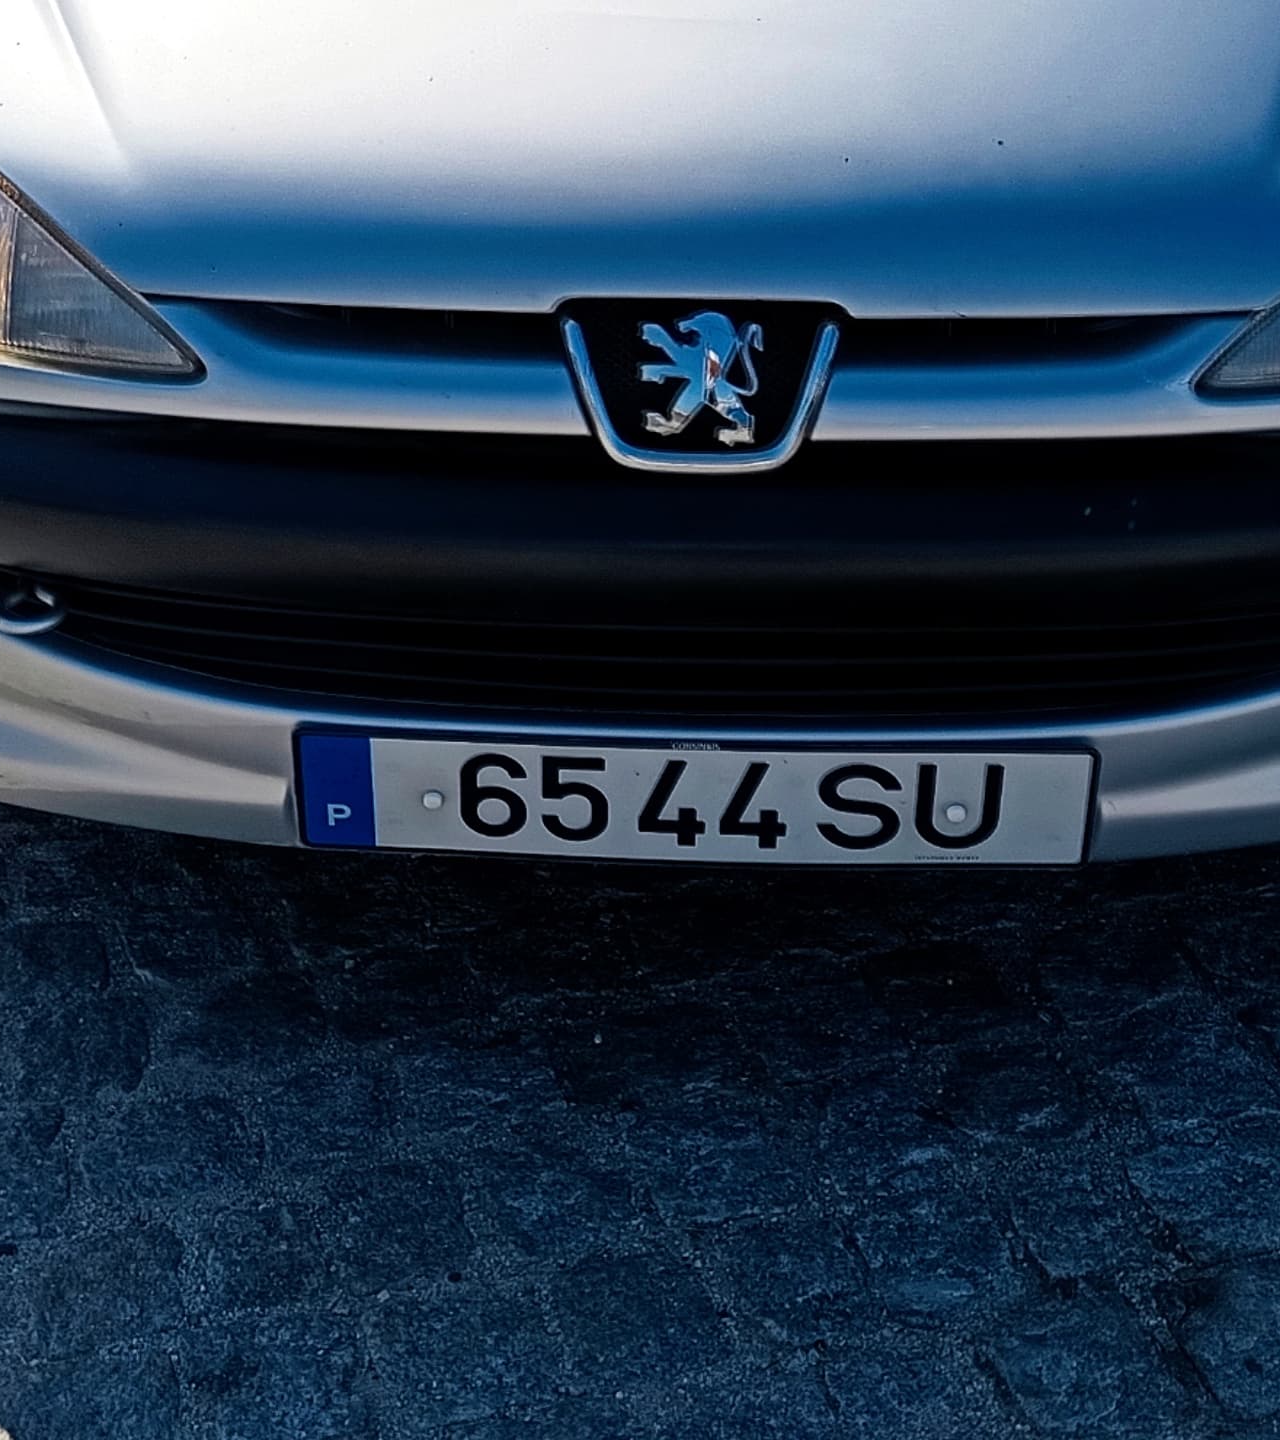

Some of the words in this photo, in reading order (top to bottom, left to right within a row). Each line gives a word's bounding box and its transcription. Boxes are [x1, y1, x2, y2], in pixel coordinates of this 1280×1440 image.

[327, 803, 352, 827] P
[459, 753, 609, 842] 65
[637, 759, 787, 849] 44
[816, 763, 1006, 850] SU
